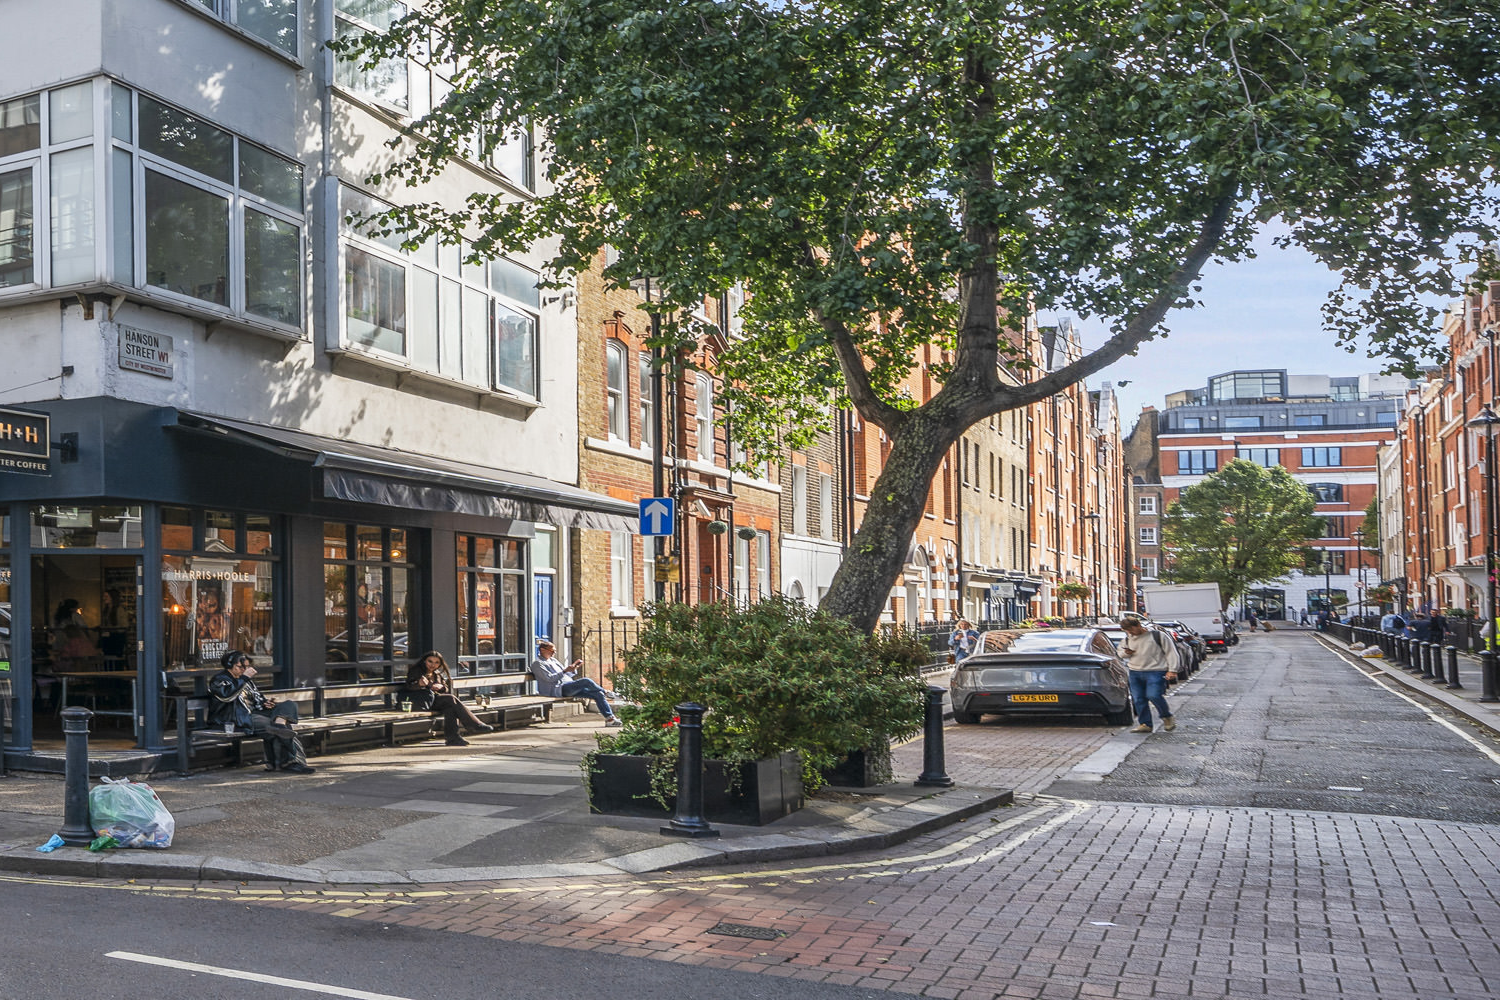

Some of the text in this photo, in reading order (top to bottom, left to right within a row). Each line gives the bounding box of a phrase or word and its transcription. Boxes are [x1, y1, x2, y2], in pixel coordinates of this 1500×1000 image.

[125, 329, 159, 348] HANSON
[125, 343, 169, 363] STREET W1
[16, 461, 47, 471] COFFEE
[174, 569, 250, 581] HARRIS+HOOLE
